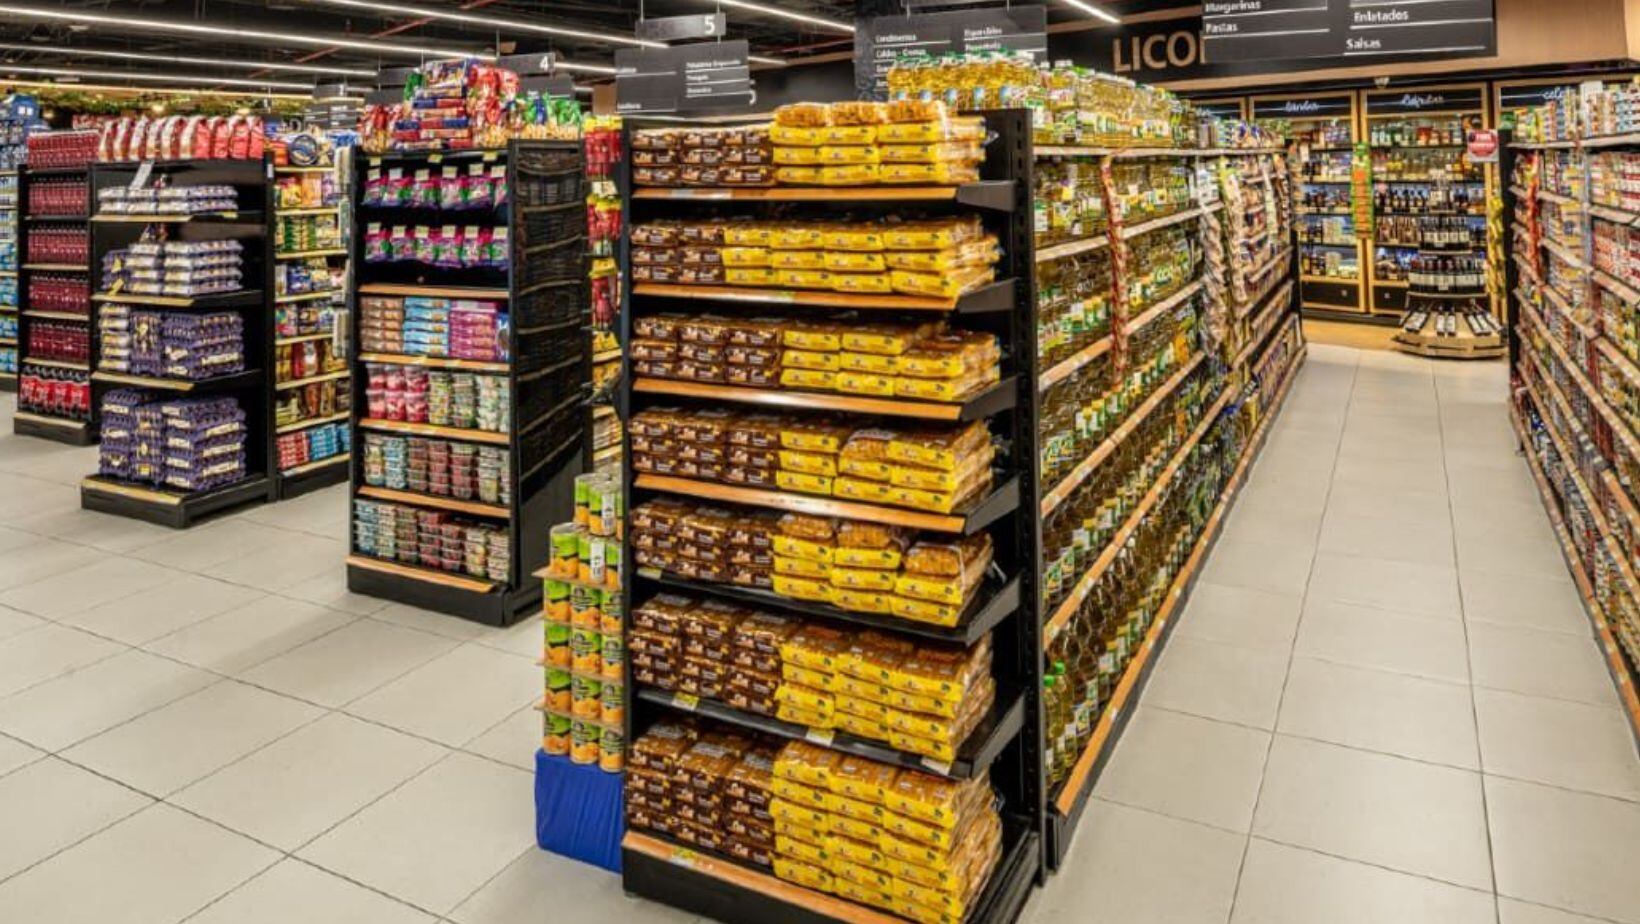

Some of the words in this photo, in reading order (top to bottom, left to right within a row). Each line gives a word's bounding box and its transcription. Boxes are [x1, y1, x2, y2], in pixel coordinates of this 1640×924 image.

[1354, 9, 1409, 23] Enlatados
[704, 15, 716, 34] 5
[1205, 23, 1238, 33] Pastas
[1346, 37, 1382, 50] Salsas
[1113, 30, 1206, 73] LICO
[539, 55, 549, 72] 4
